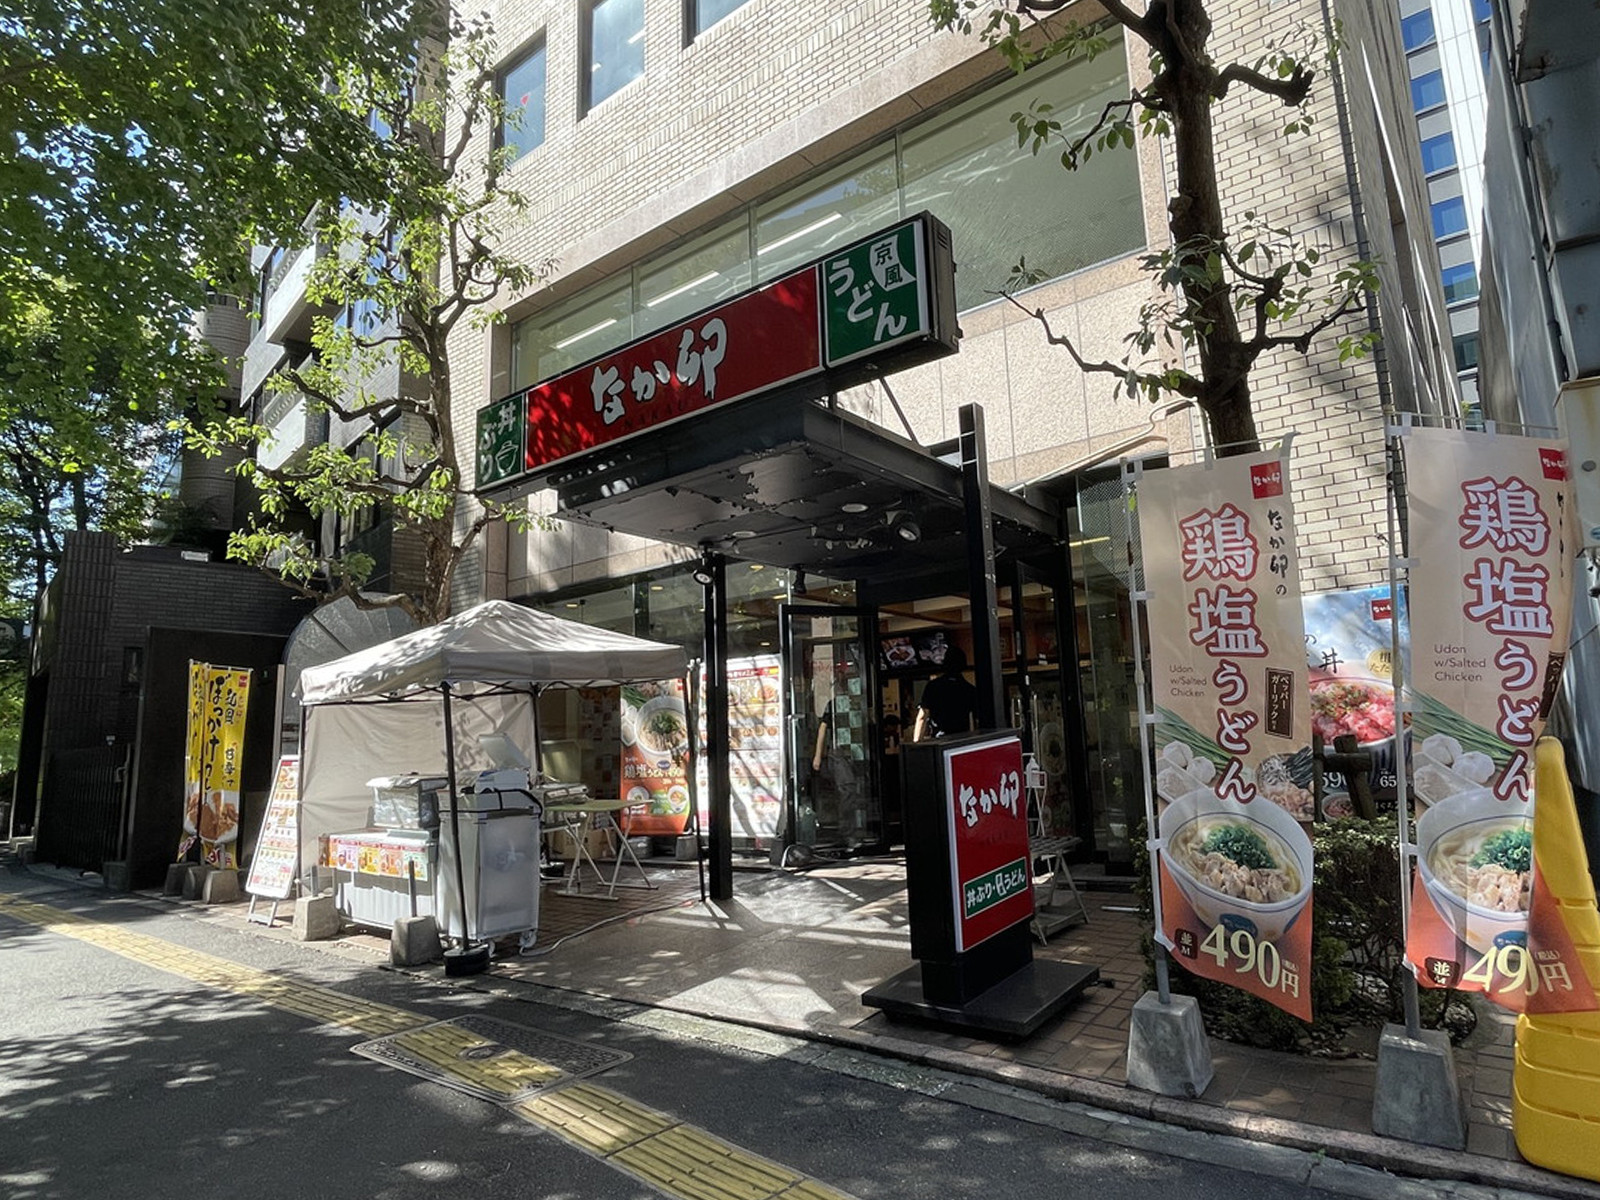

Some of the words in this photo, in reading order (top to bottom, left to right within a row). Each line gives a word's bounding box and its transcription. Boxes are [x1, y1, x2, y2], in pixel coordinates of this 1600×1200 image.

[874, 242, 903, 288] 京風
[828, 258, 908, 342] うどん
[590, 317, 728, 425] なか卯
[1267, 508, 1289, 596] なか卯の
[1180, 503, 1269, 804] 鶏塩うどん
[1434, 643, 1467, 654] Udon
[1459, 476, 1554, 801] 鶏塩うどん
[1169, 664, 1194, 673] Udon
[1434, 658, 1486, 668] w/Salted
[1434, 671, 1483, 682] Chicken
[1170, 688, 1205, 697] Chicken
[959, 769, 1020, 828] なか卯
[1433, 961, 1451, 976] 並
